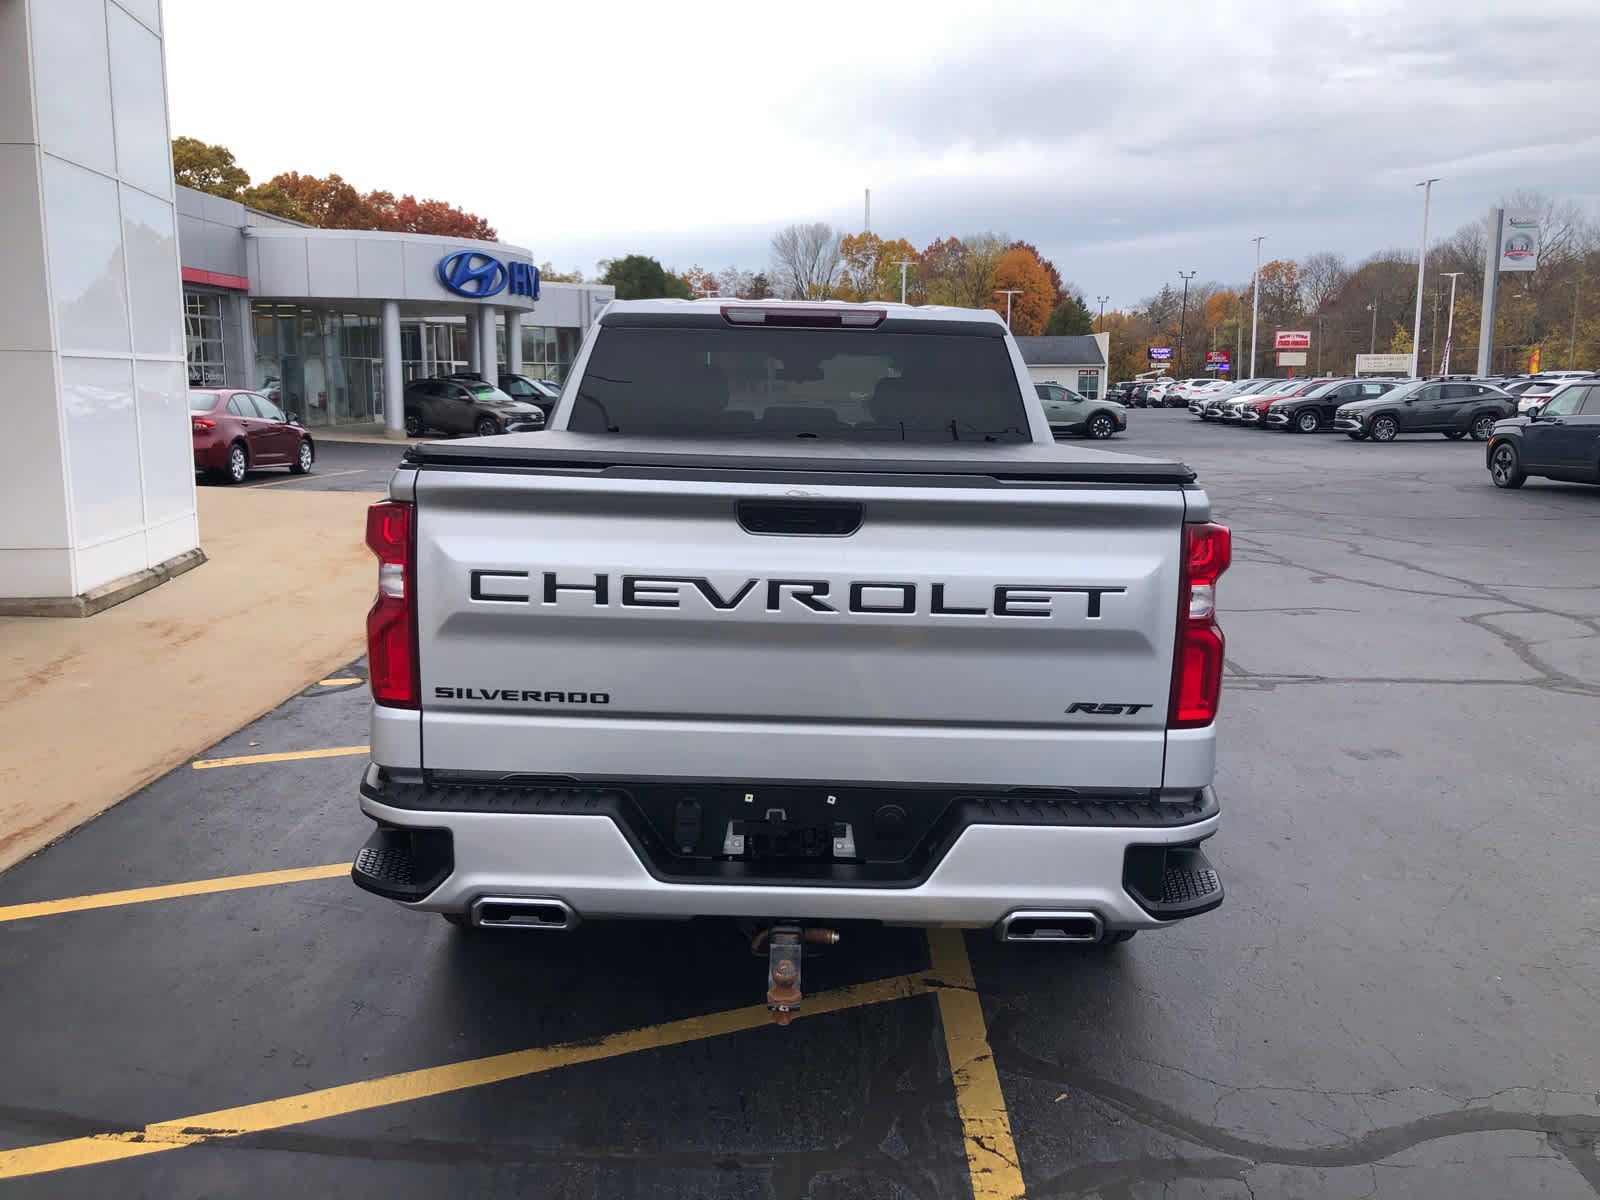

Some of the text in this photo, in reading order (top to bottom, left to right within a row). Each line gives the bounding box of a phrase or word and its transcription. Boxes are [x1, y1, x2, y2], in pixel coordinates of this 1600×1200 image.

[509, 262, 540, 300] HY
[469, 569, 1128, 620] CHEVROLET
[435, 687, 610, 704] SILVERADO
[1064, 702, 1154, 715] RST
